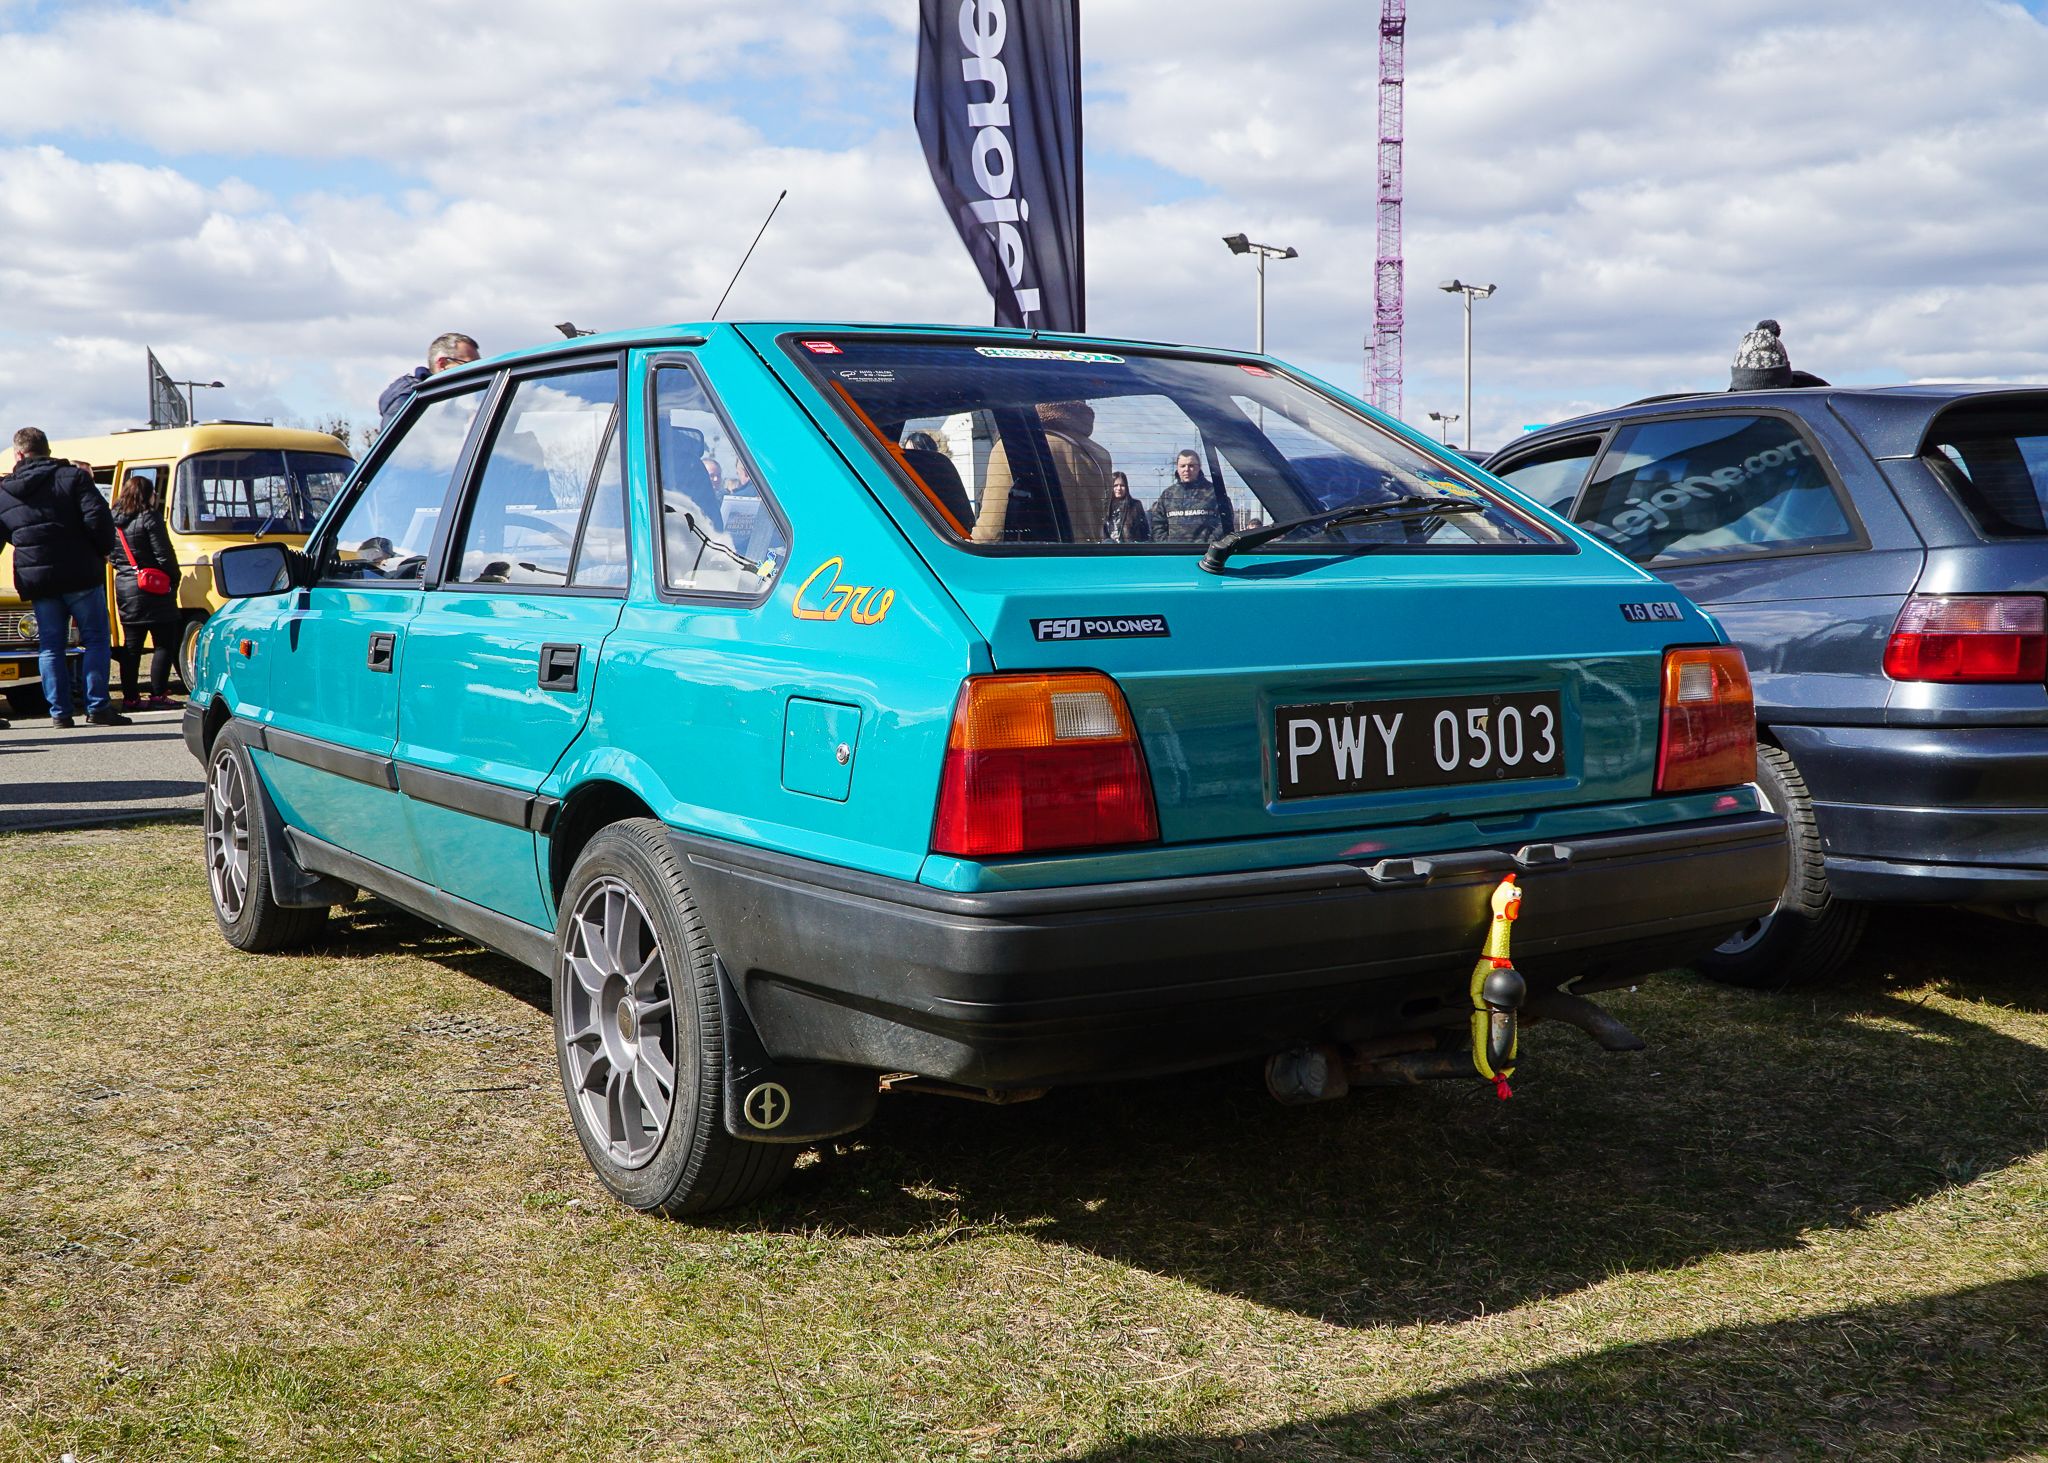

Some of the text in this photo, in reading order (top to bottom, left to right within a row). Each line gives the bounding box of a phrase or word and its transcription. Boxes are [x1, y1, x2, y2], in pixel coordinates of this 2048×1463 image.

[1038, 619, 1081, 639] FSO
[1288, 704, 1556, 784] PWY 0503
